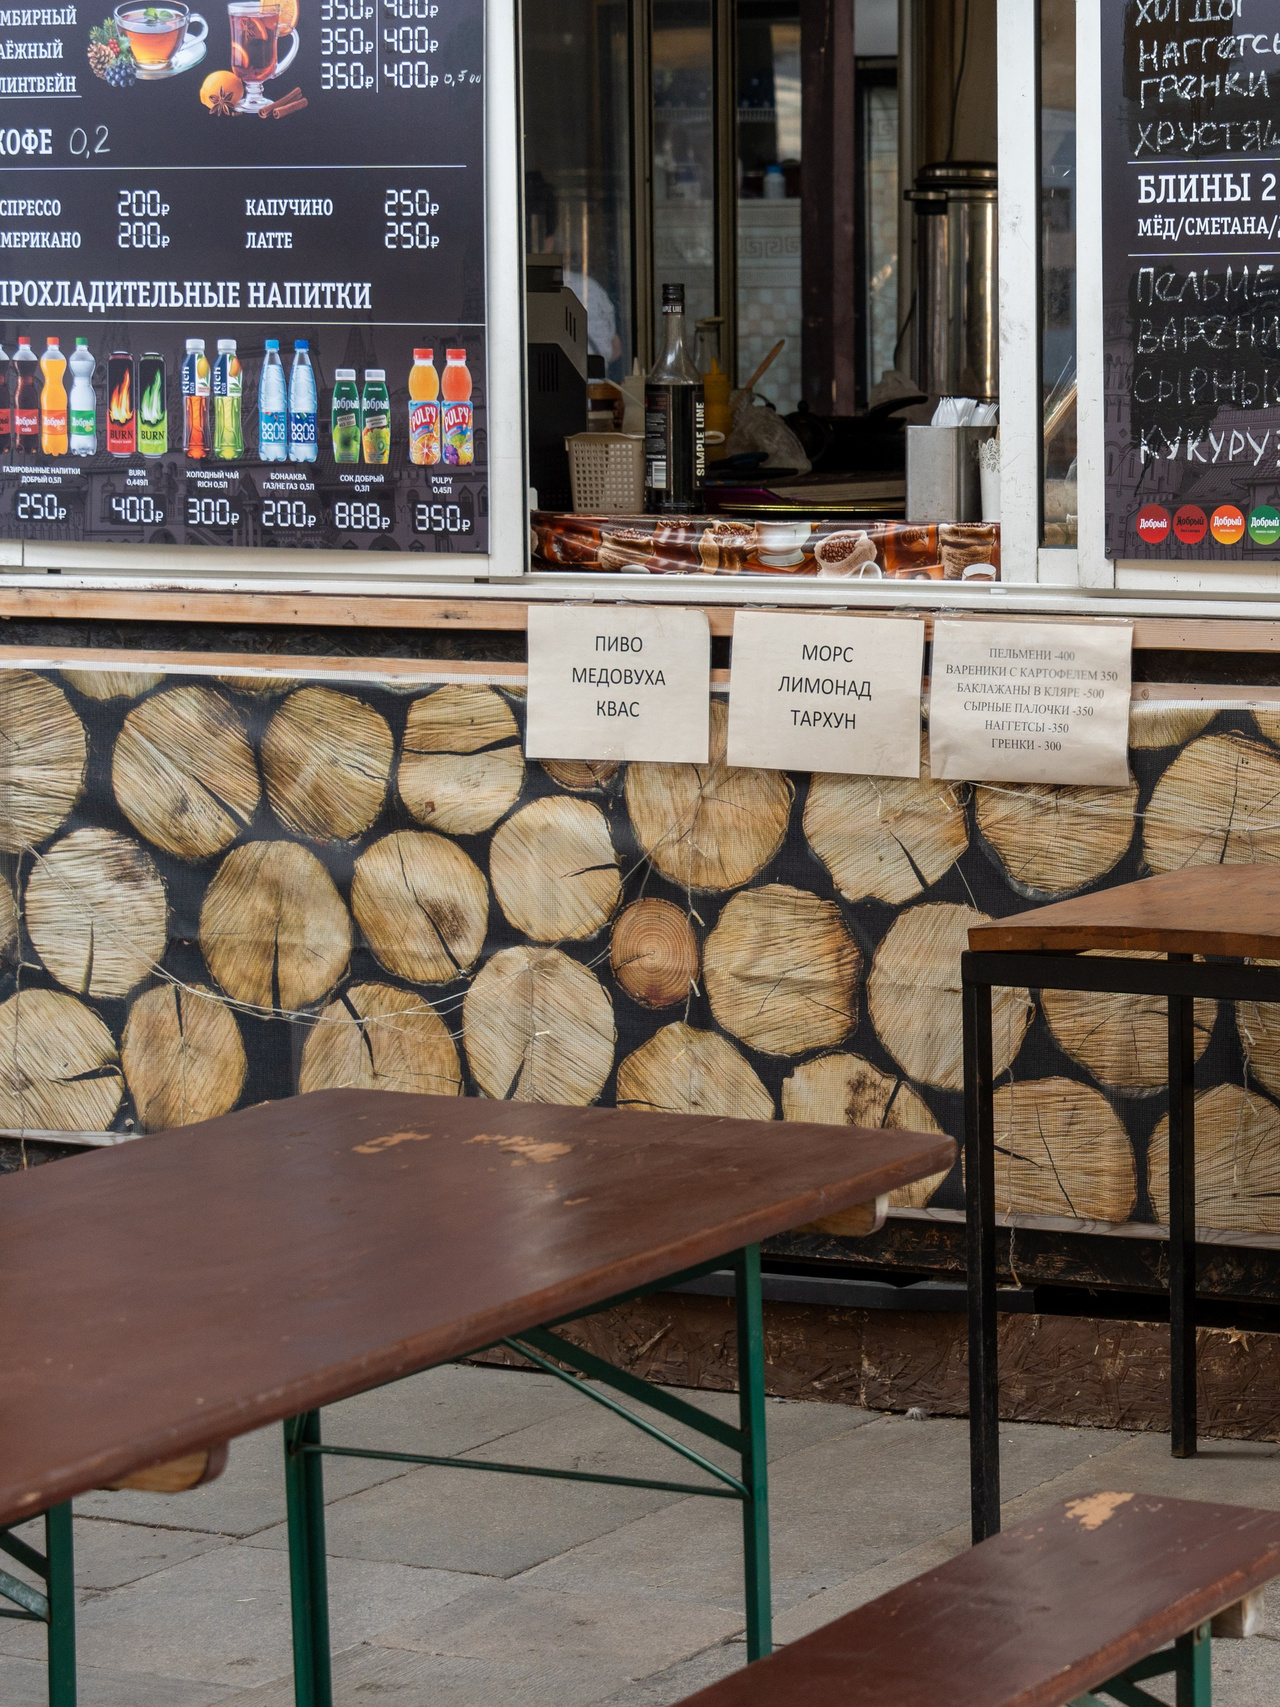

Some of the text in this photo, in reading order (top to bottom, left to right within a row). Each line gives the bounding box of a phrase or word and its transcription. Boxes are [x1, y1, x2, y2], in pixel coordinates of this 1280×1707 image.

[321, 26, 439, 55] 350₽ 400₽
[321, 61, 439, 90] 350₽ 400₽
[69, 125, 111, 159] 0,2
[1138, 173, 1251, 203] БЛИНЫ
[1261, 173, 1277, 201] 2
[118, 190, 170, 217] 200₽
[245, 198, 334, 216] КАПУЧИНО
[384, 189, 440, 216] 250₽
[118, 222, 170, 248] 200₽
[245, 231, 293, 249] ЛАТТЕ
[384, 222, 440, 249] 250₽
[247, 281, 372, 310] НАПИТКИ
[182, 366, 190, 394] Rich
[262, 422, 285, 432] bona
[291, 422, 315, 432] bona
[412, 406, 437, 432] PULPY
[444, 406, 469, 432] PULPY
[110, 429, 133, 439] BURN
[141, 430, 165, 440] BURN
[262, 432, 285, 442] aqua
[291, 432, 315, 442] aqua
[695, 402, 705, 477] SIMPLE LINE
[2, 466, 81, 475] ГАЗИРОВАННЫЕ НАПИТКИ
[21, 475, 48, 484] ДОБРЫЙ
[186, 470, 239, 479] ХОЛОДНЫЙ ЧАЙ
[270, 472, 307, 481] БОНААКВА
[340, 474, 384, 483] СОК ДОБРЫЙ
[263, 482, 285, 490] ГАЗ/НЕ
[18, 493, 67, 520] 250₽
[112, 497, 164, 523] 400₽
[188, 498, 240, 526] 300₽
[262, 500, 317, 528] 200₽
[335, 502, 391, 530] 888₽
[416, 504, 471, 532] 350₽
[1140, 519, 1167, 529] Добрый
[1176, 516, 1204, 526] Добрый
[1213, 516, 1242, 527] Добрый
[1250, 517, 1280, 528] Добрый
[595, 635, 643, 653] ПИВО
[802, 644, 854, 663] МОРС
[989, 648, 1075, 661] ПЕЛЬМЕНИ -400
[572, 667, 666, 687] МЕДОВУХА
[946, 664, 1118, 681] ВАРЕНИКИ С КАРТОФЕЛЕМ 350
[779, 676, 872, 701] ЛИМОНАД
[957, 682, 1105, 699] БАКЛАЖАНЫ В КЛЯРЕ -500
[596, 701, 640, 718] КВАС
[964, 701, 1094, 716] СЫРНЫЕ ПАЛОЧКИ -350
[790, 709, 856, 730] ТАРХУН
[985, 720, 1069, 733] НАГГЕТСЫ -350
[991, 738, 1035, 750] ГРЕНКИ
[1044, 741, 1061, 751] 300
